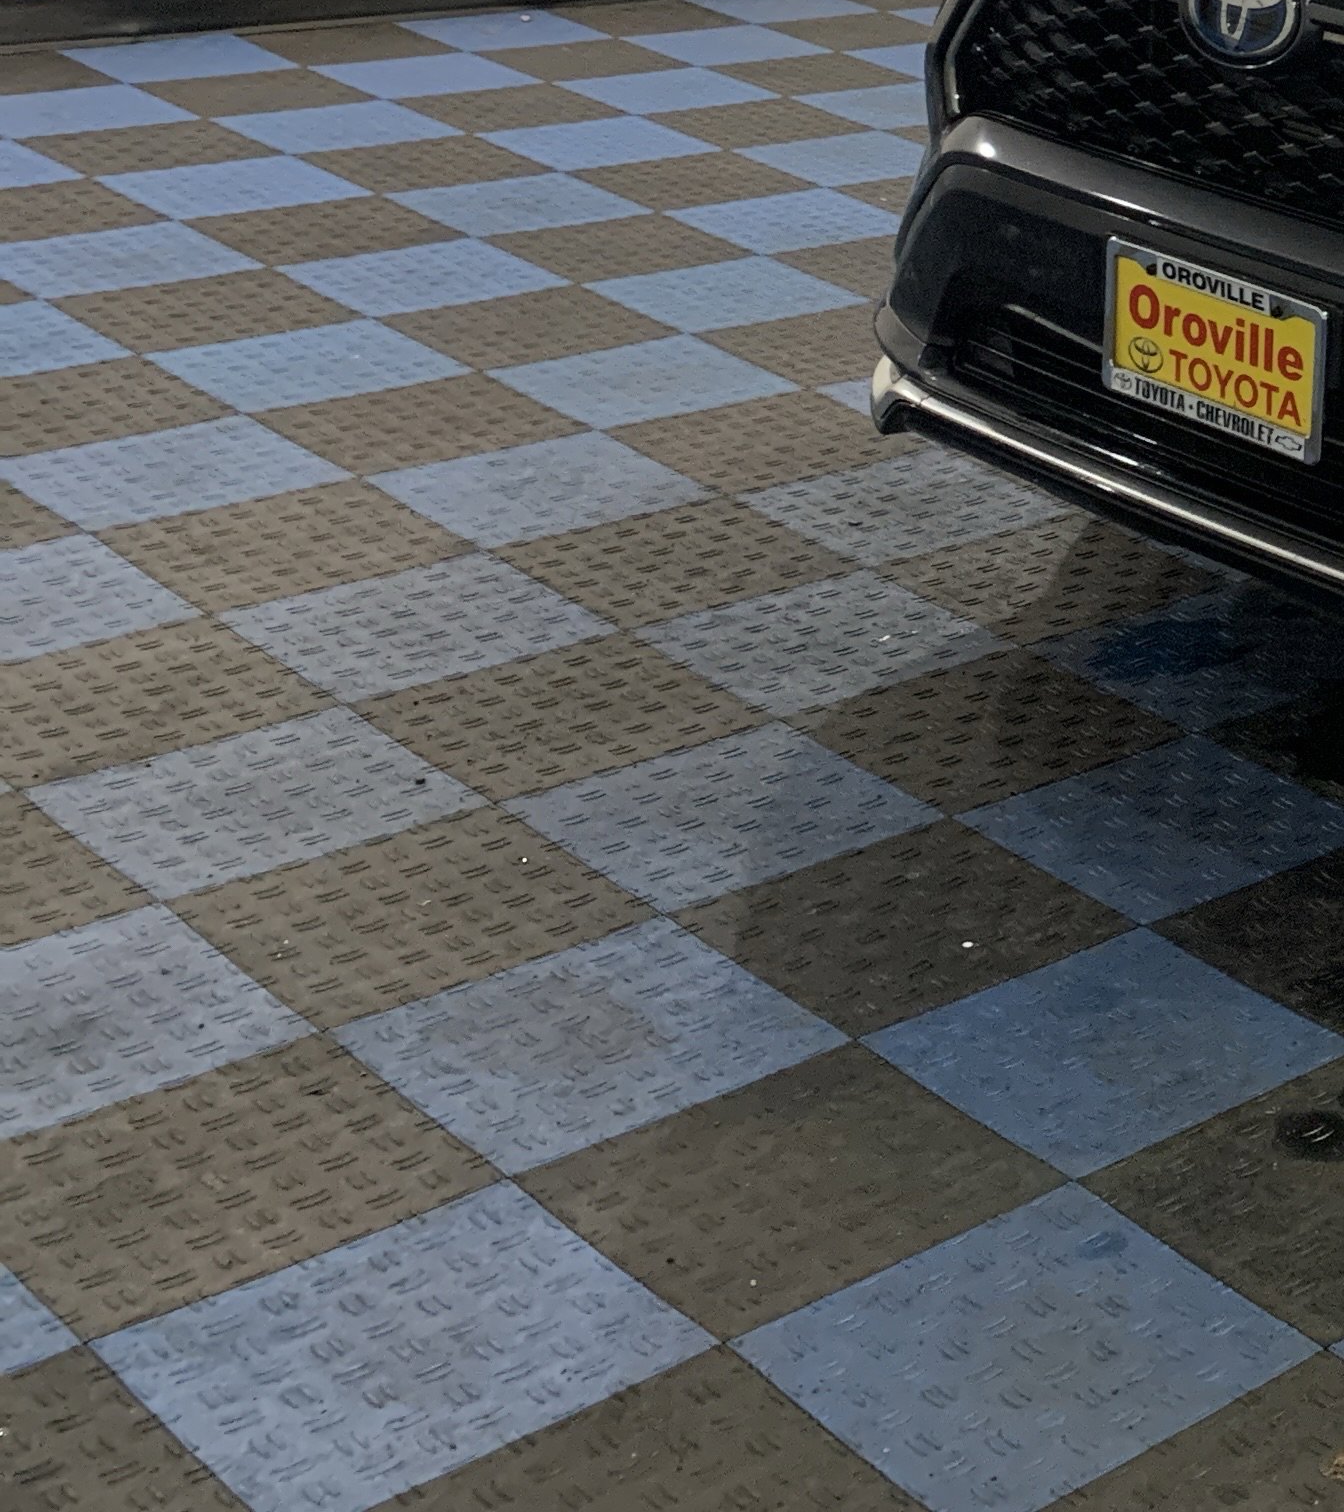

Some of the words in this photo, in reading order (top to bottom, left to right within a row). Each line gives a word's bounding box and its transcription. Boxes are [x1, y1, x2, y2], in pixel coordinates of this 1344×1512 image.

[1162, 262, 1265, 311] OROVILLE
[1129, 284, 1304, 381] Oroville
[1134, 376, 1185, 412] TOYOTA
[1196, 400, 1275, 445] CHEVROLET
[1168, 349, 1302, 427] TOYOTA
